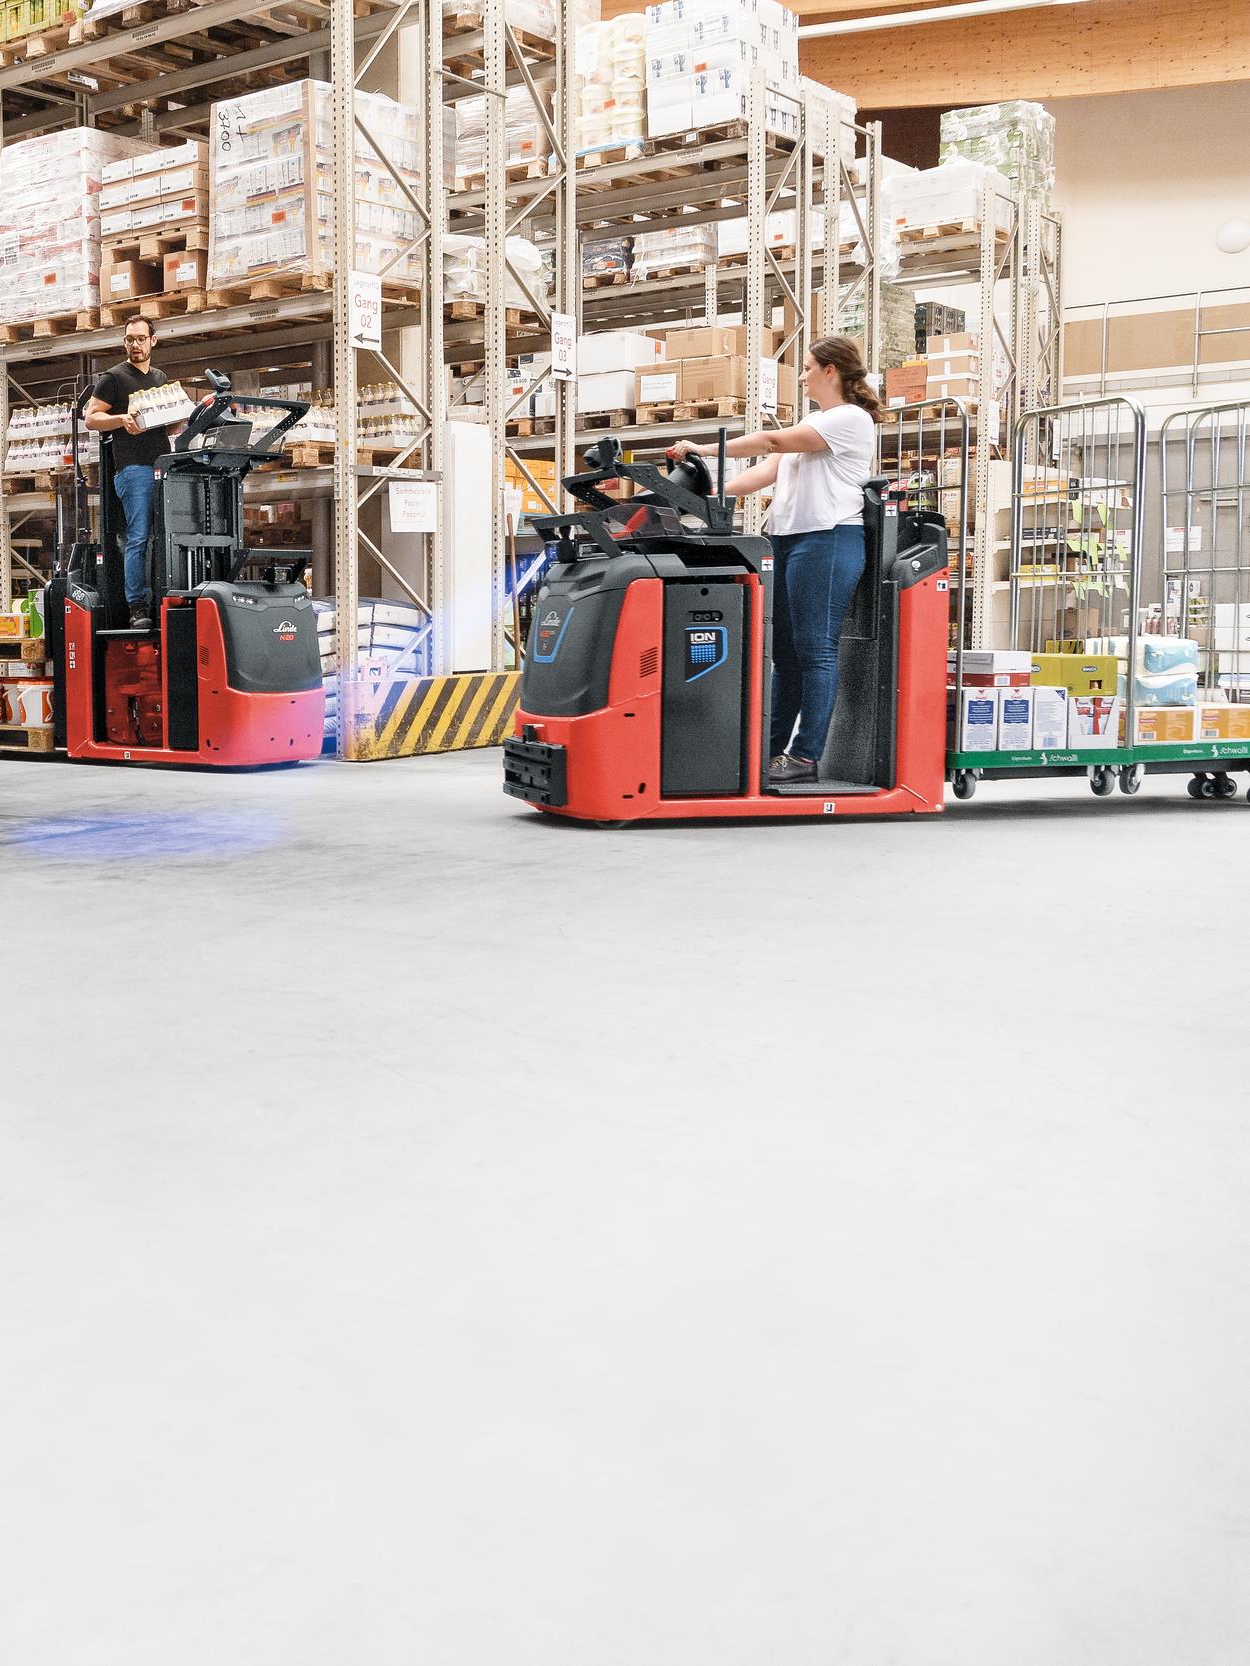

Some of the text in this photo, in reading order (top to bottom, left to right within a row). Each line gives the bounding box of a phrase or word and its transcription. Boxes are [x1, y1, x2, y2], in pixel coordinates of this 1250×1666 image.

[354, 293, 378, 315] Gang
[360, 313, 372, 329] 02
[554, 331, 572, 350] Gang
[558, 349, 567, 362] 03
[762, 373, 776, 389] Gang
[273, 620, 297, 633] Linde
[690, 632, 716, 642] ION
